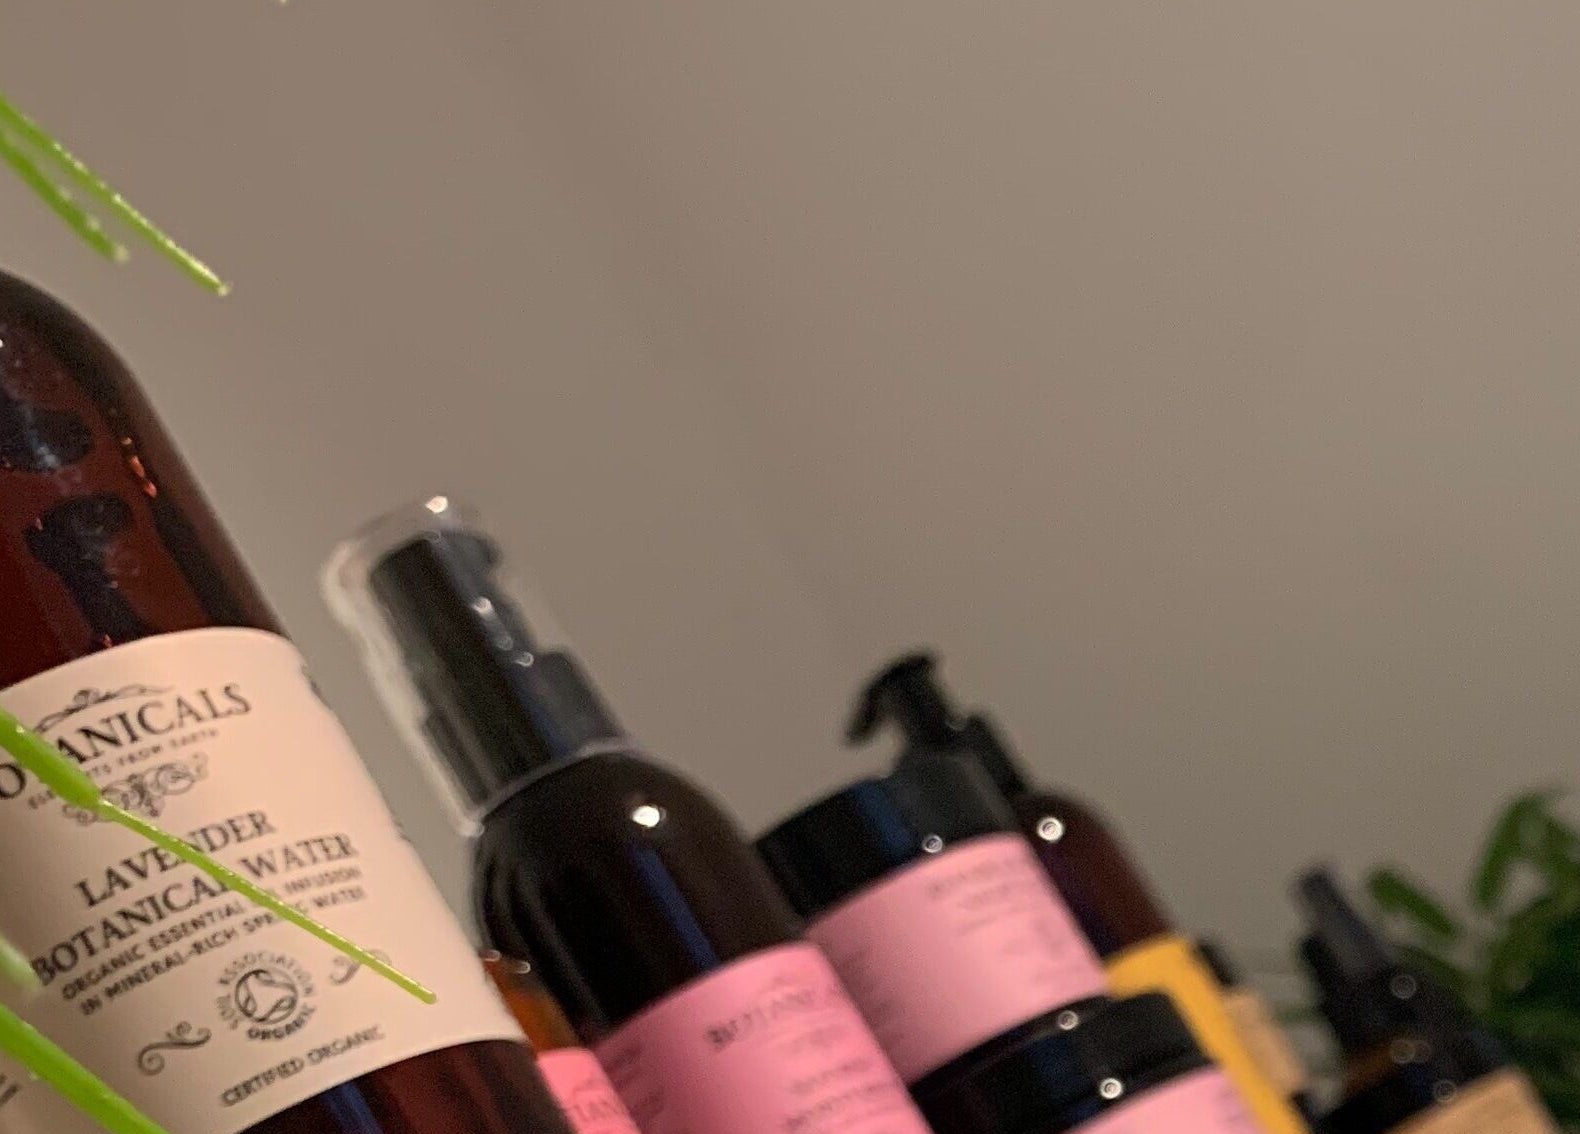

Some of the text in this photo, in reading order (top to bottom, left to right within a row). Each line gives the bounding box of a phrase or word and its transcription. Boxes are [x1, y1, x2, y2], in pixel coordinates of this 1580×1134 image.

[31, 832, 359, 986] BOTANICA WATER
[62, 943, 145, 1000] ORGANIC
[149, 901, 244, 951] ESSENTIAL
[285, 866, 362, 893] INFUSION
[221, 1024, 386, 1107] CERTIFIED ORGANIC
